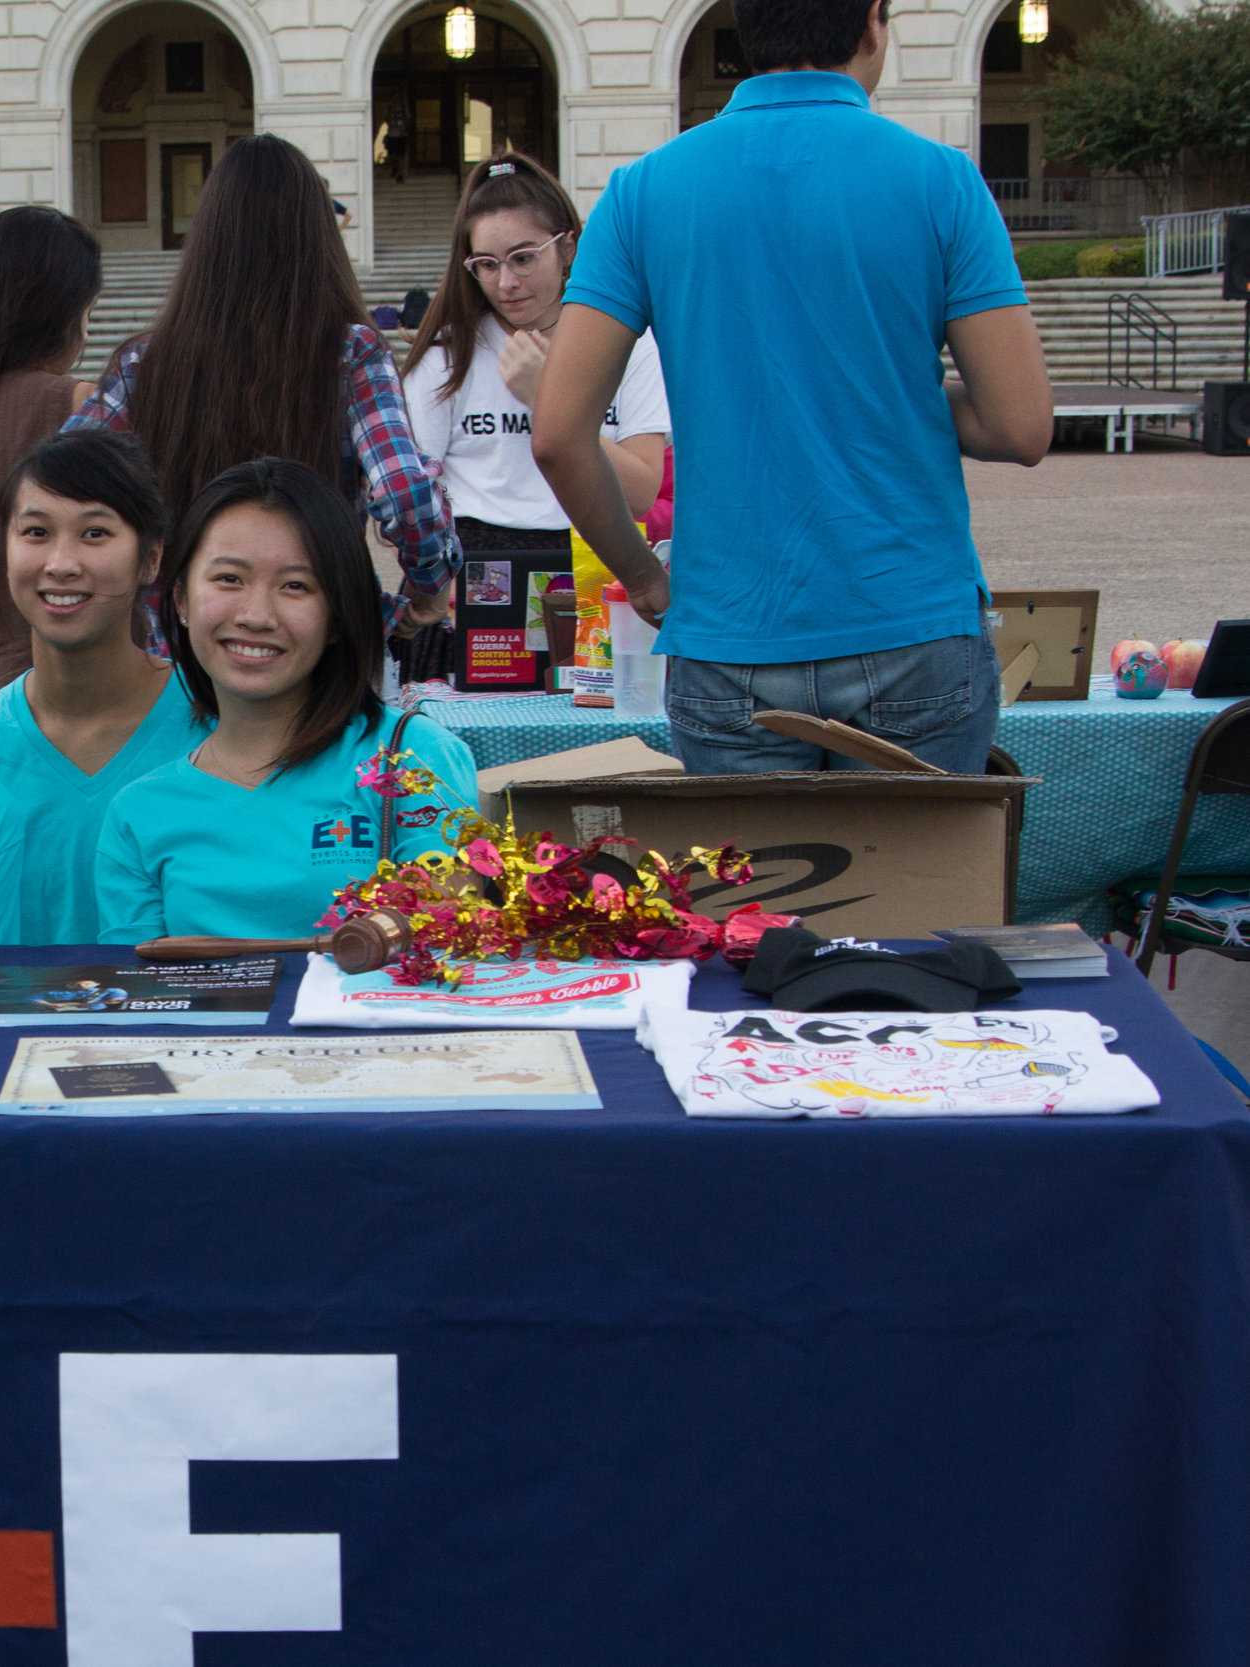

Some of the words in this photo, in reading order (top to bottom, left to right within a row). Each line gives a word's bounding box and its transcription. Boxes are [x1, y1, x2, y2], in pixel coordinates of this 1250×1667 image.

[462, 413, 495, 435] YES
[472, 651, 512, 659] CONTRA
[472, 659, 511, 667] DROGAS
[312, 814, 375, 849] E+E
[550, 976, 620, 1000] Bubble
[165, 1049, 237, 1057] TRY
[255, 1045, 463, 1057] CULTURE
